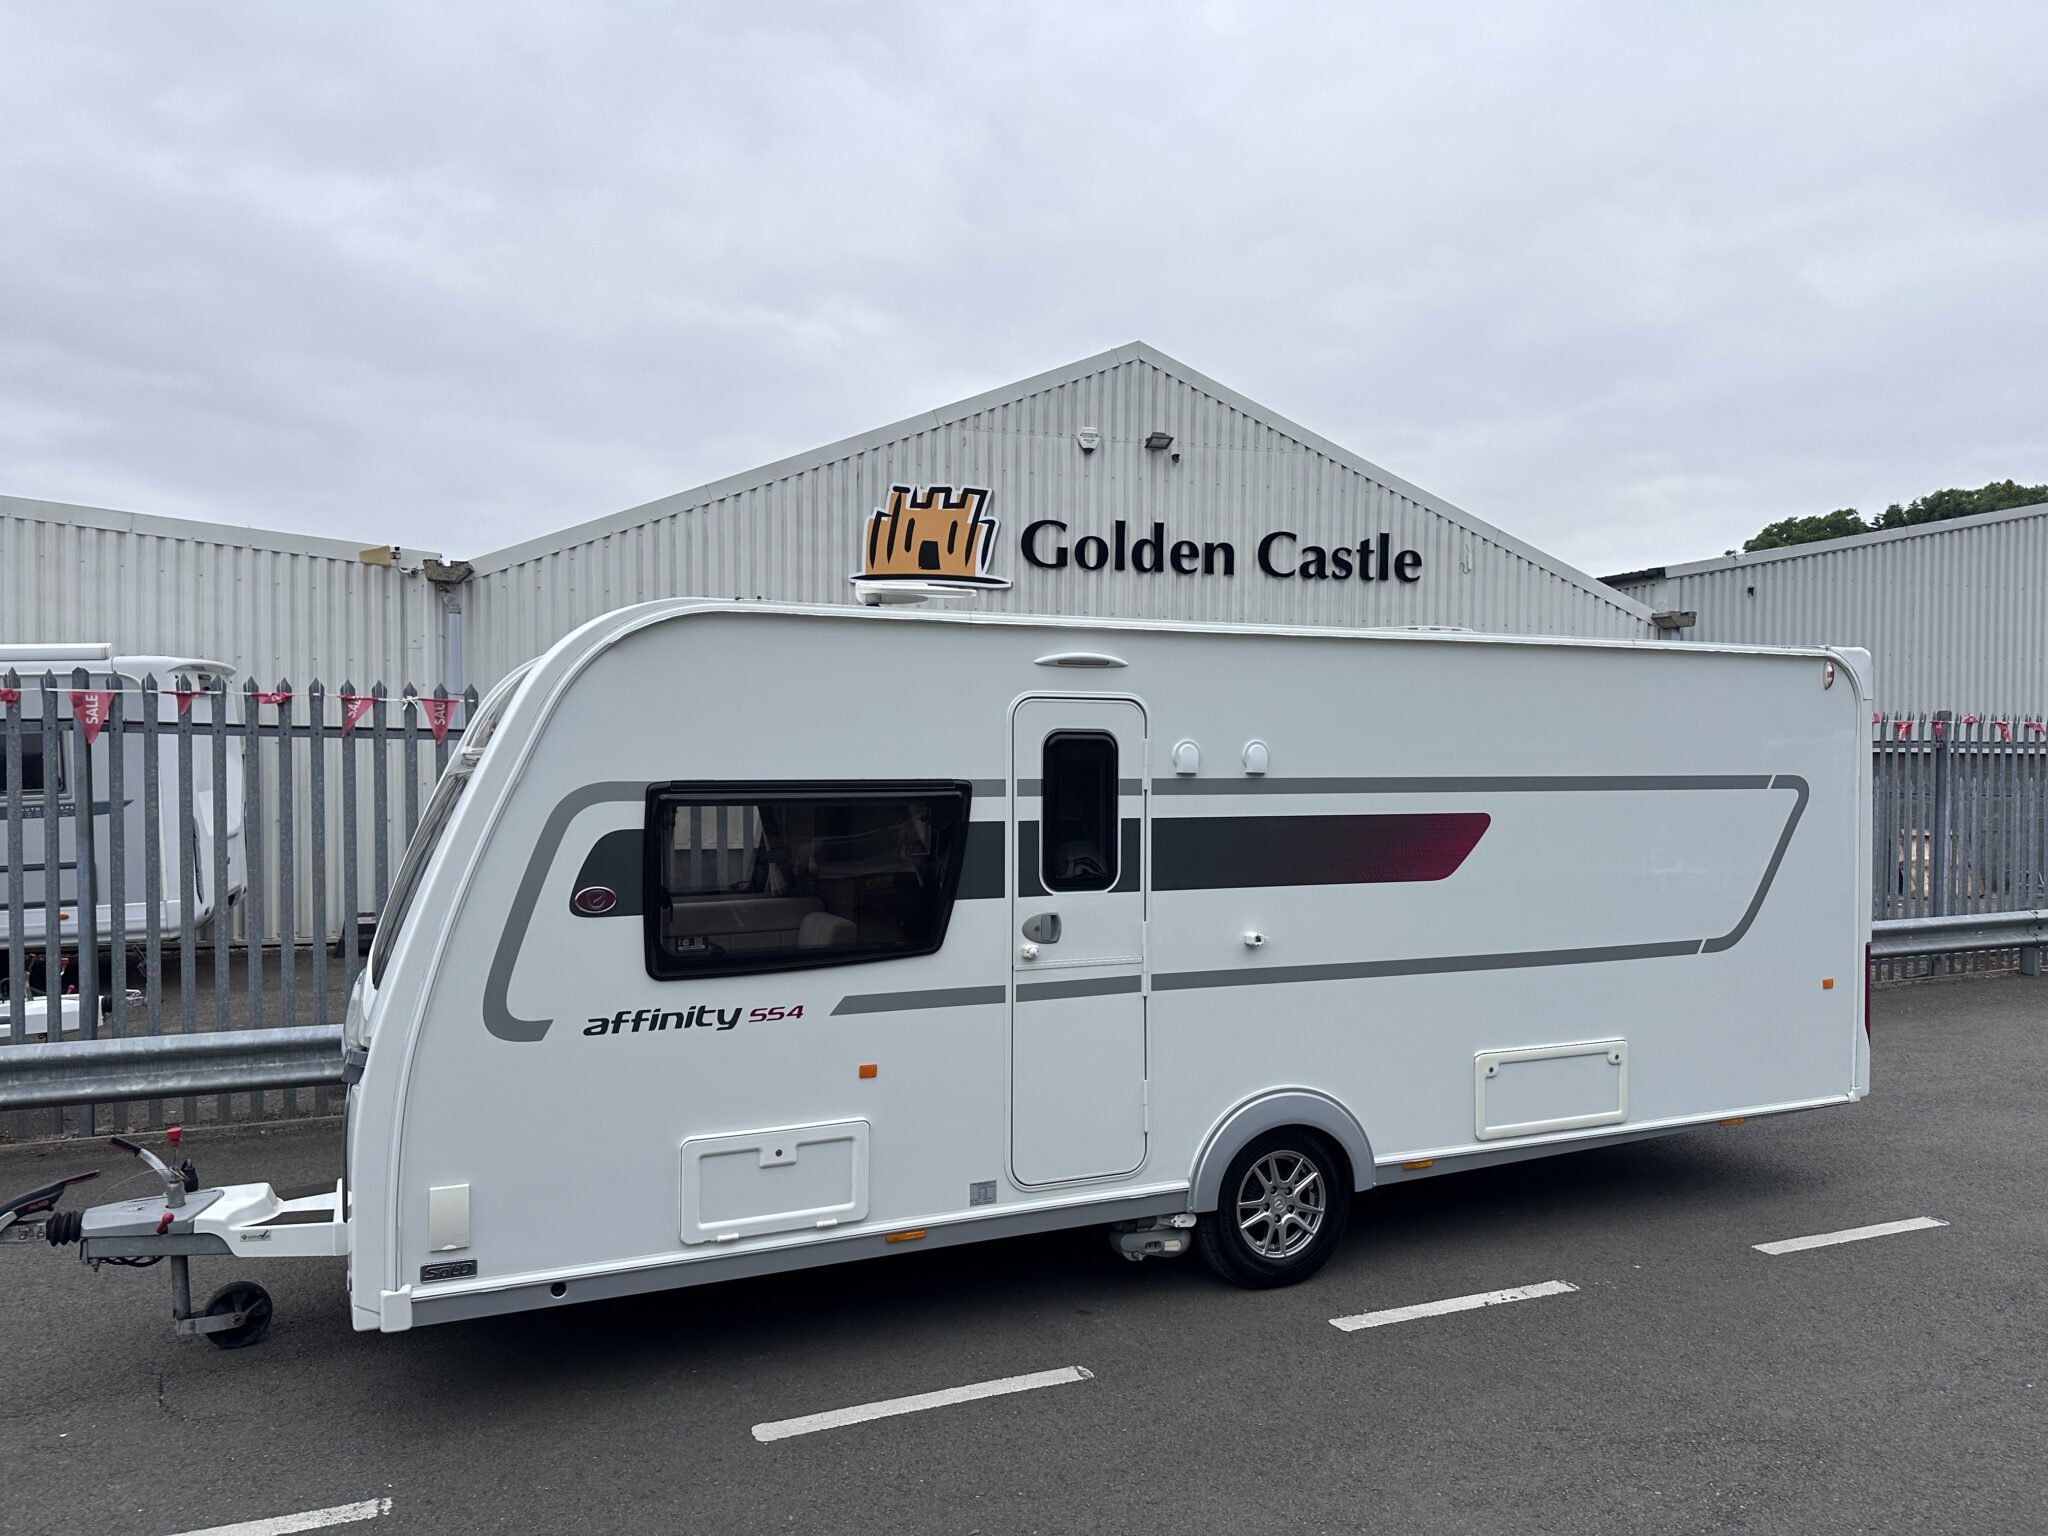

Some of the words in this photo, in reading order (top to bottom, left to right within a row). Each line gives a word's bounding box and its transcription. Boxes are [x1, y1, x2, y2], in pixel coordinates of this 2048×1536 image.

[1020, 519, 1235, 576] Golden
[1257, 531, 1423, 582] Castle
[85, 695, 99, 724] SALE
[582, 1005, 743, 1036] affinity
[748, 1005, 804, 1023] SS4
